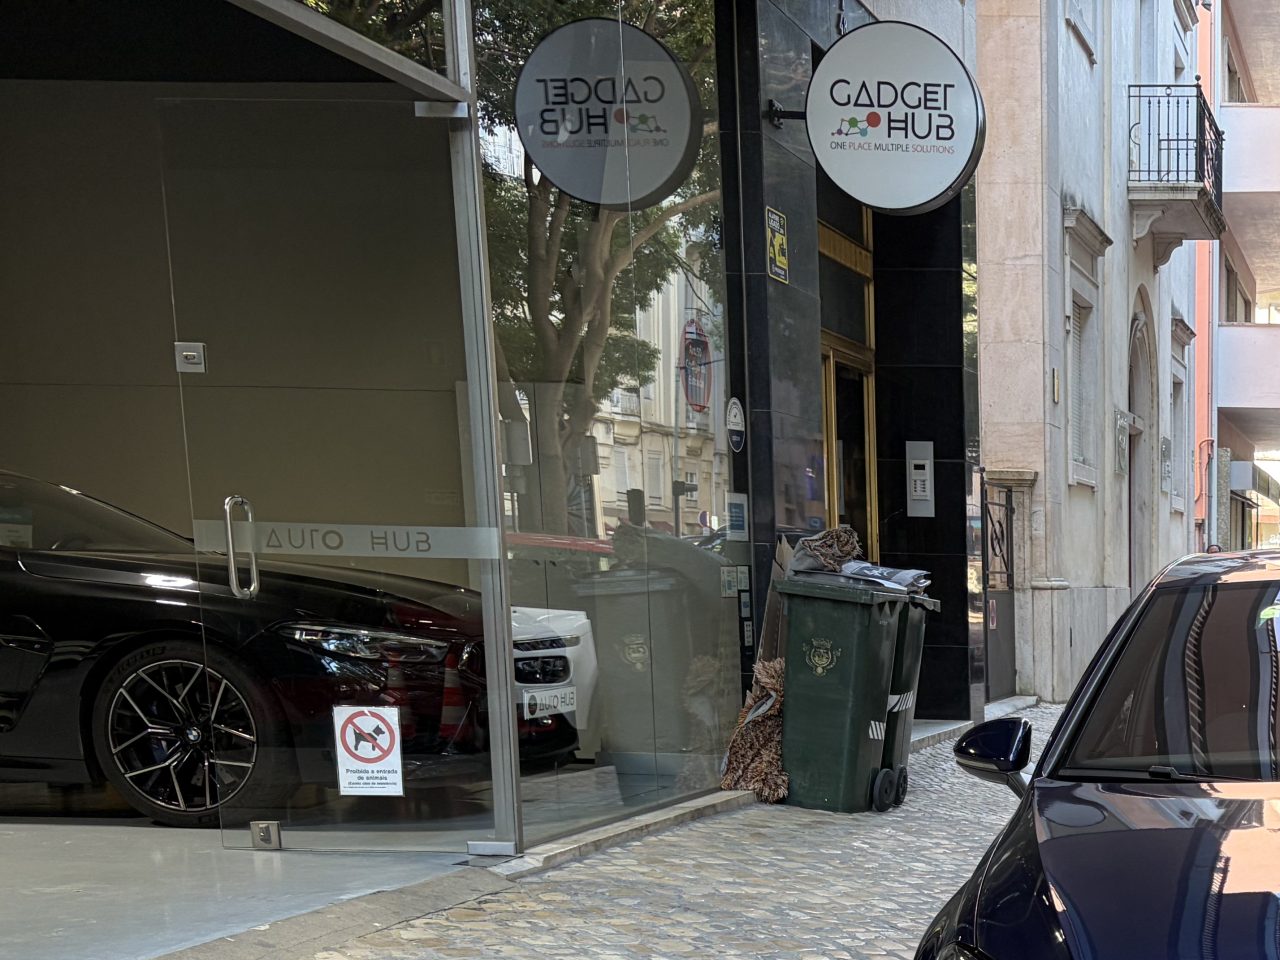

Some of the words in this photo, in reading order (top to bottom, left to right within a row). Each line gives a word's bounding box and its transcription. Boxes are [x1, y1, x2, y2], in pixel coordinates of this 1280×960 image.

[830, 78, 955, 111] GADGET
[887, 111, 955, 141] HUB
[830, 141, 847, 150] ONE
[848, 142, 872, 151] PLACE
[874, 143, 910, 153] MULTIPLE
[911, 144, 955, 155] SOLUTIONS
[266, 527, 344, 551] AUTO
[370, 530, 432, 553] HUB
